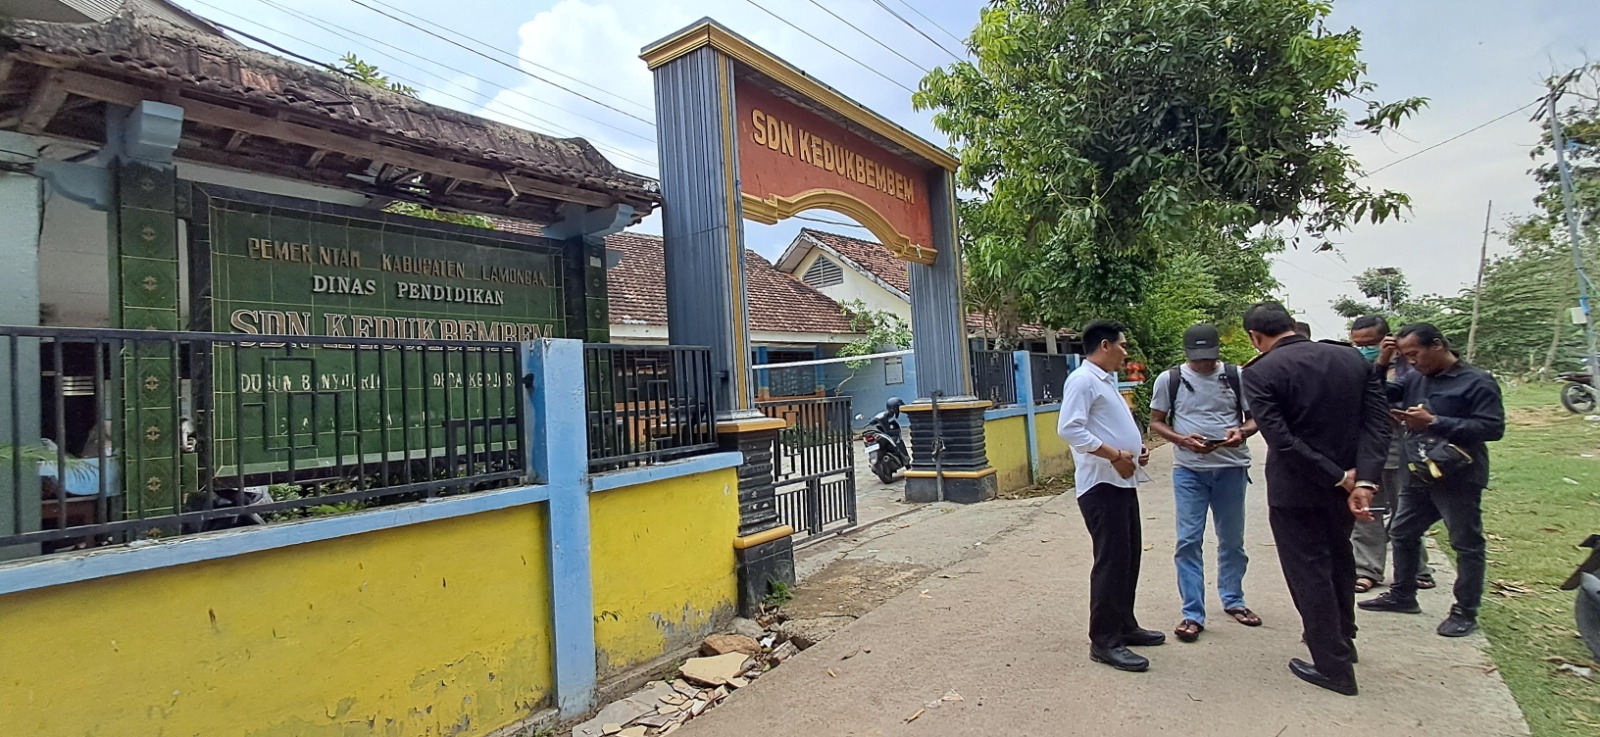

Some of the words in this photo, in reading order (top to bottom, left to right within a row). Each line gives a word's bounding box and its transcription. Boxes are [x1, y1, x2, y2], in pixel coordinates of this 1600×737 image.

[752, 109, 794, 157] SDN
[799, 128, 914, 205] KEDUKBEMBEM
[248, 237, 361, 269] PEMERNTAH
[382, 253, 466, 278] KABUPATEN
[481, 264, 547, 287] LAMONGAN
[313, 274, 377, 296] DINAS
[397, 281, 505, 306] PENDIDIKAN
[230, 309, 311, 348] SDN
